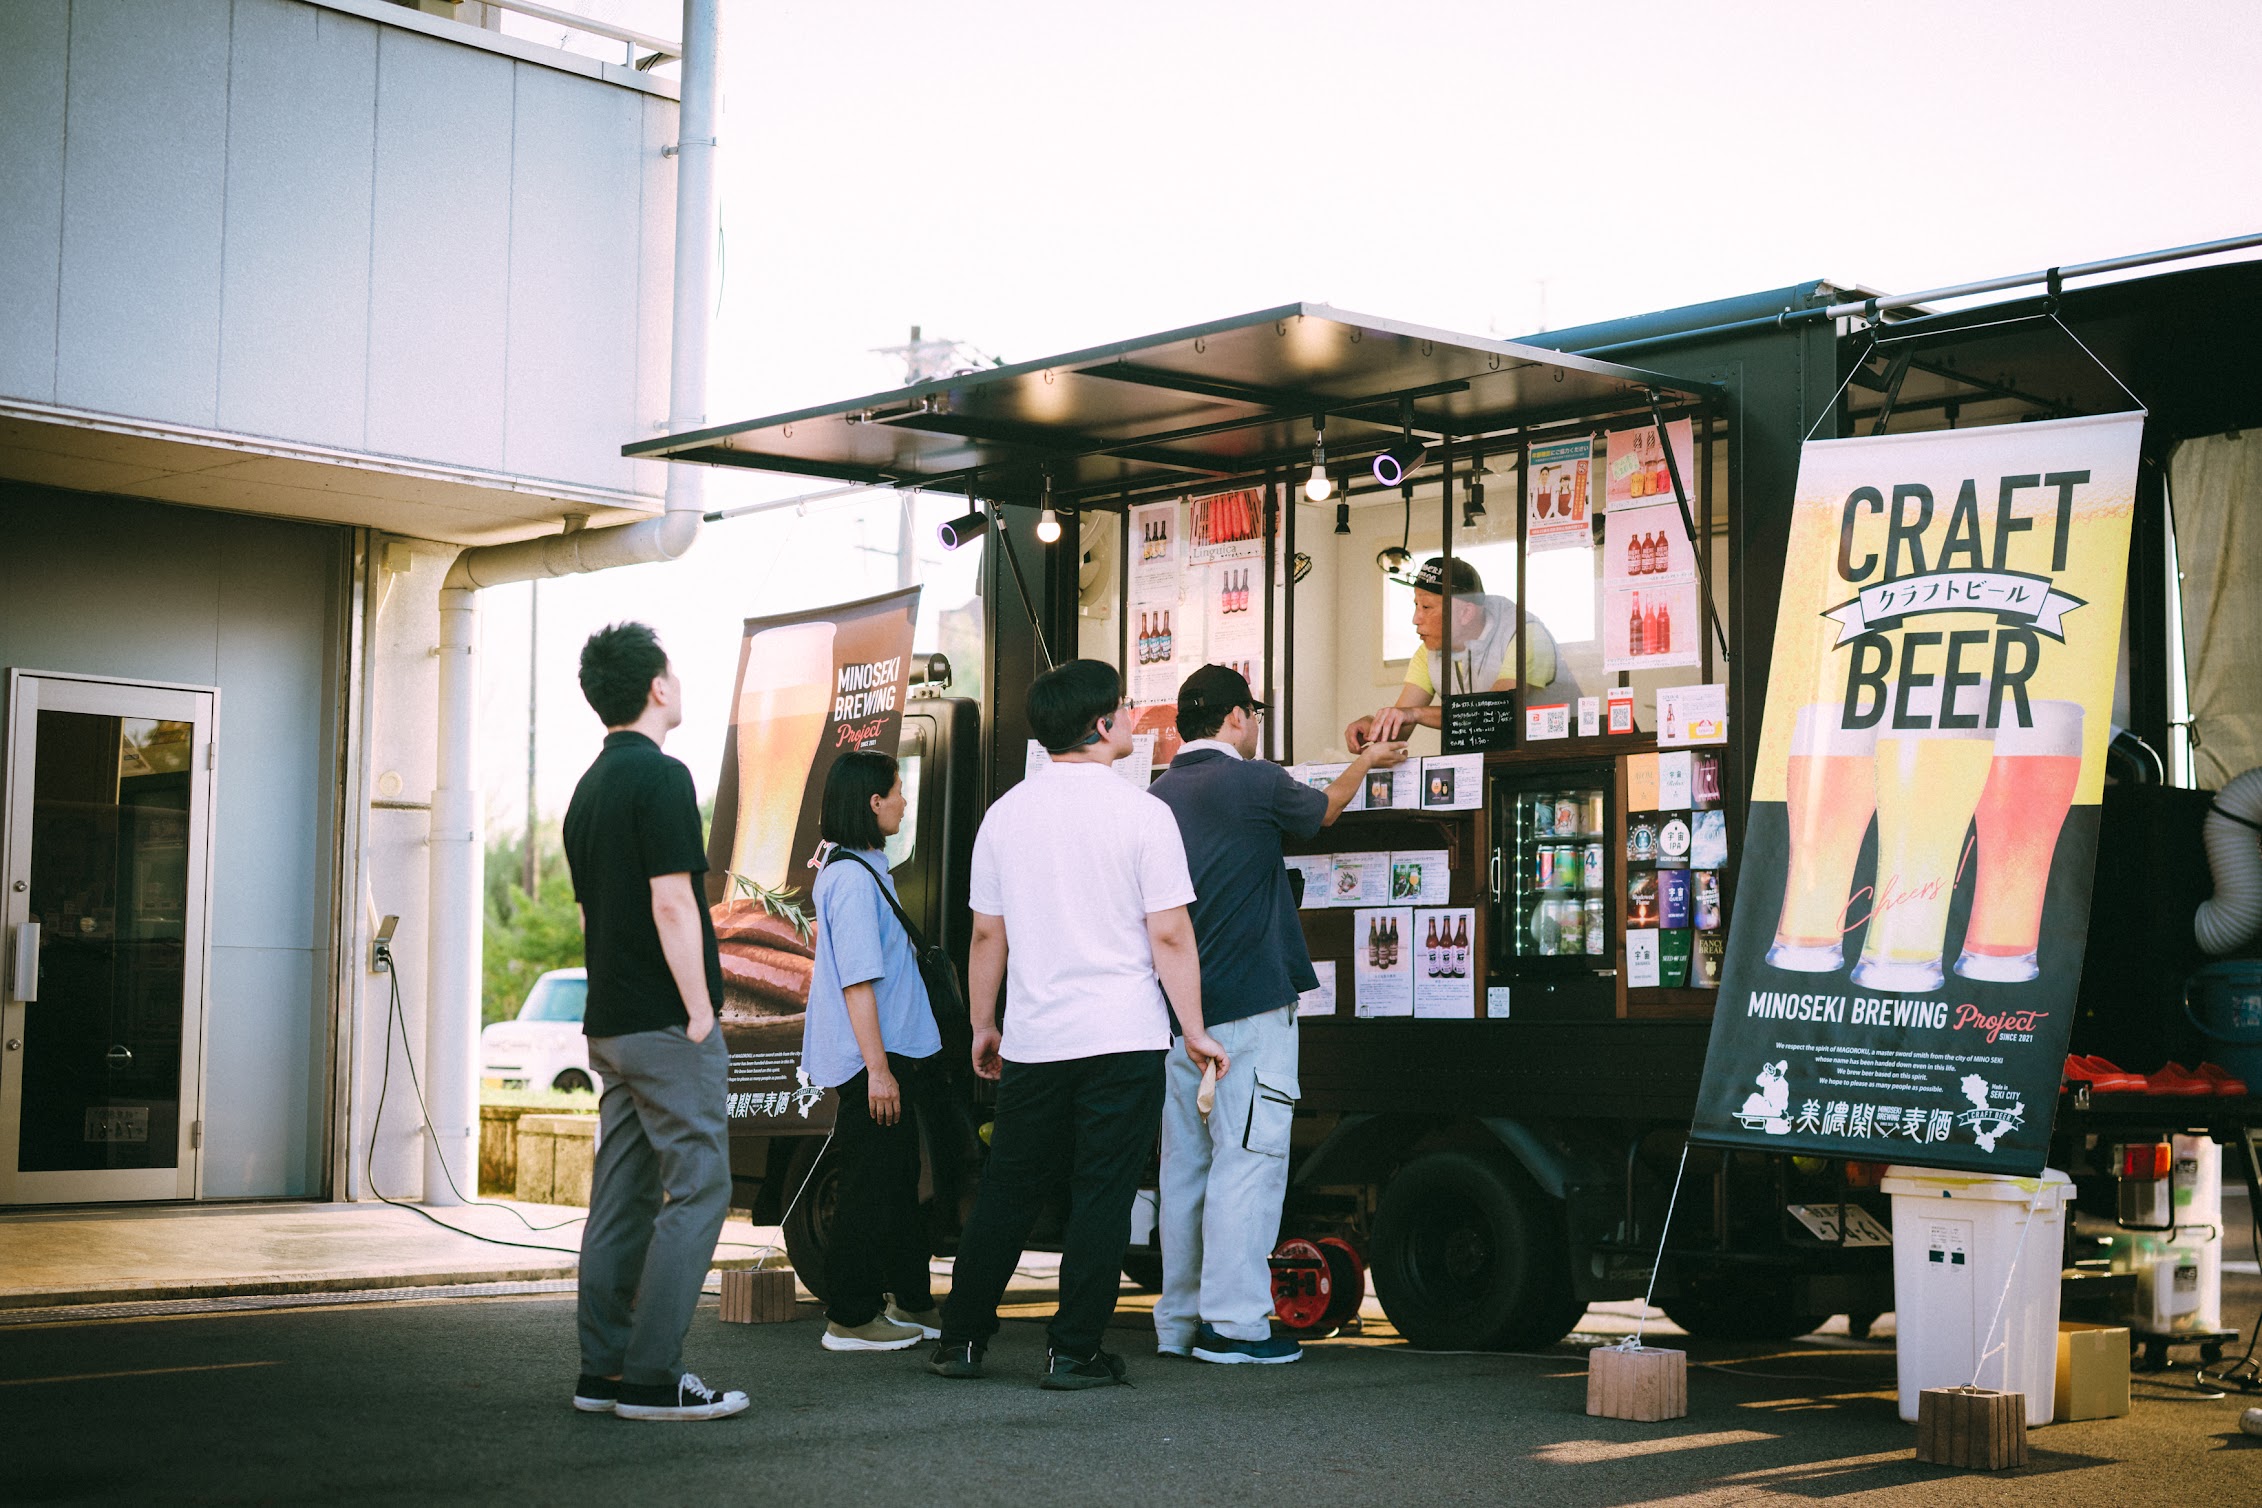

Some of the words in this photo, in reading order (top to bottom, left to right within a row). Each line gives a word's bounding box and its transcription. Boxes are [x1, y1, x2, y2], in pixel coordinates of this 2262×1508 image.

[1837, 469, 2091, 582] CRAFT
[1879, 580, 2031, 613] クラフトビール
[837, 656, 900, 693] MINOSEKI
[1841, 620, 2040, 730] BEER
[834, 686, 896, 722] BREWING
[835, 718, 889, 752] Project
[1668, 832, 1684, 841] 宇宙
[1586, 851, 1598, 868] 4
[1698, 946, 1723, 954] BREAK
[1747, 991, 1846, 1023] MINOSEKI
[1851, 998, 1948, 1029] BREWING
[1953, 1004, 2049, 1044] Project
[1999, 1032, 2017, 1041] SINCE
[2019, 1034, 2033, 1042] 2021
[1785, 1043, 1805, 1051] respect
[1895, 1050, 1913, 1058] sword
[1930, 1052, 1944, 1060] from
[1955, 1055, 1966, 1063] city
[1850, 1080, 1868, 1088] please
[1875, 1070, 1891, 1078] based
[1911, 1073, 1928, 1081] spirit.
[1990, 1090, 2005, 1099] SEKI
[2006, 1091, 2020, 1100] CITY
[1876, 1113, 1901, 1121] BREWING
[1877, 1105, 1902, 1114] MINOSEKI
[1995, 1112, 2011, 1122] BEER
[1796, 1098, 1875, 1139] 美濃関
[1902, 1107, 1954, 1144] 麦酒
